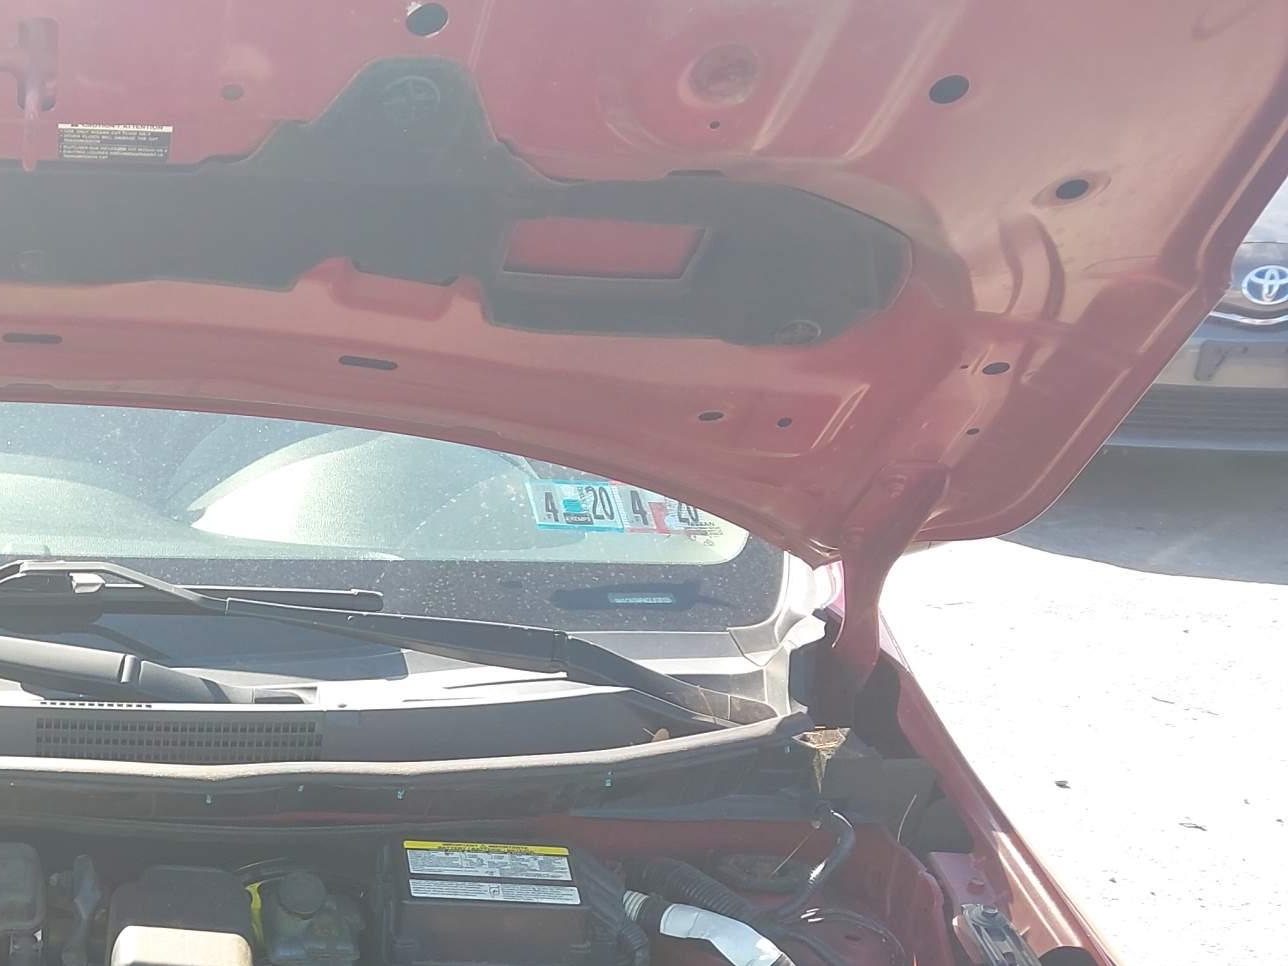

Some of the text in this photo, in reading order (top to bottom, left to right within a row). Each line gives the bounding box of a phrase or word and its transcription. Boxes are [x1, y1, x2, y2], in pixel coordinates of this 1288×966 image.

[544, 491, 560, 523] 4
[584, 485, 615, 521] 20
[630, 490, 649, 526] 4
